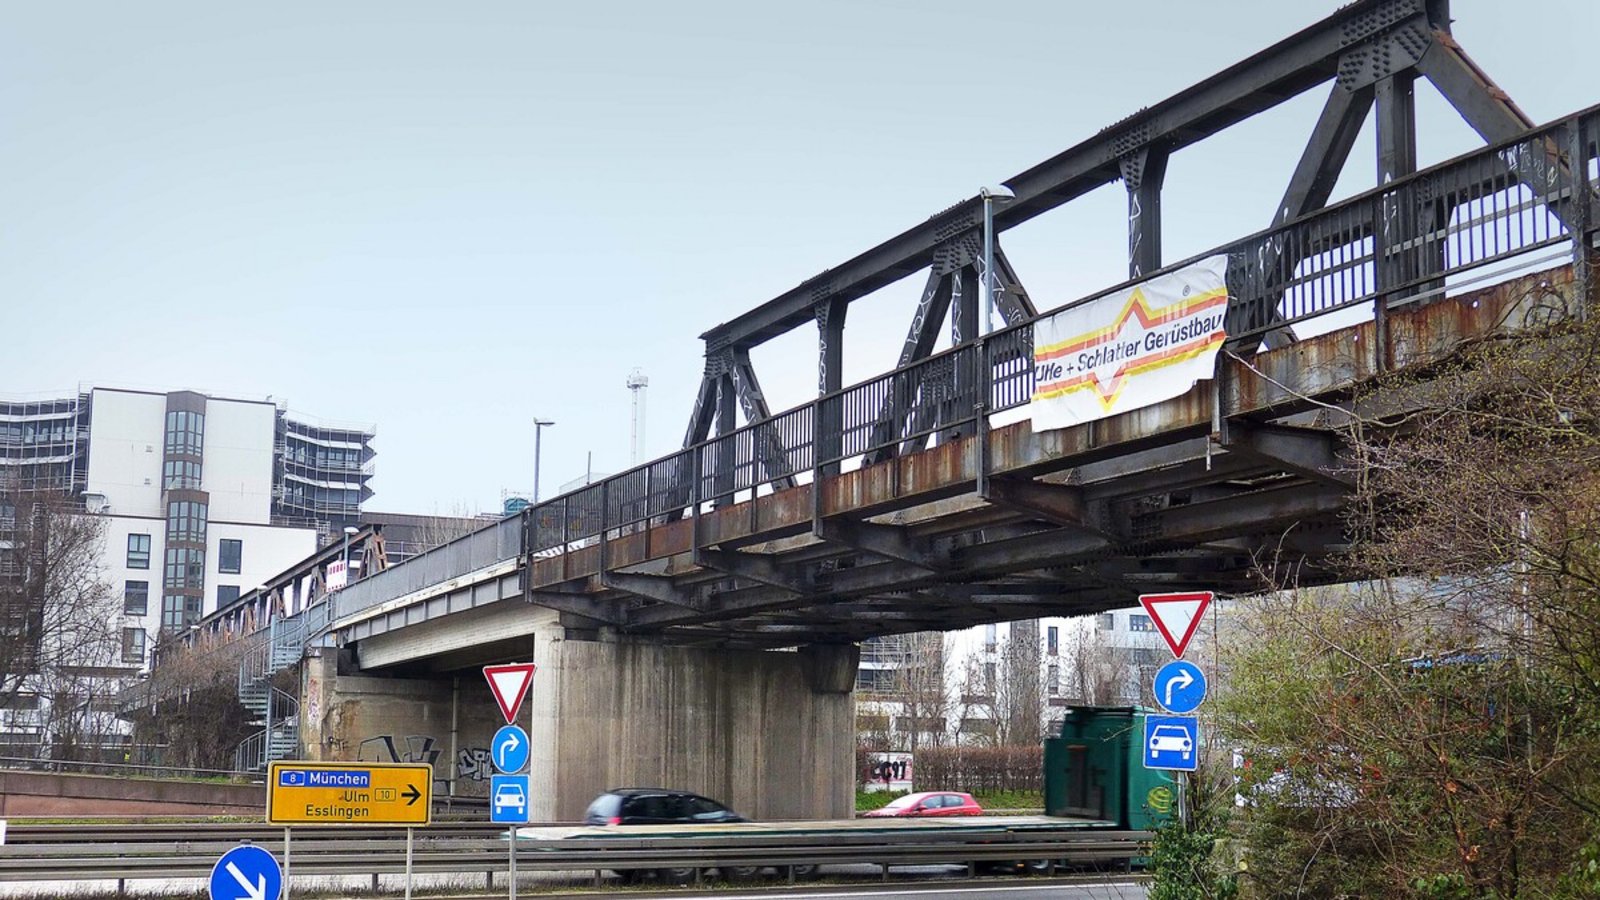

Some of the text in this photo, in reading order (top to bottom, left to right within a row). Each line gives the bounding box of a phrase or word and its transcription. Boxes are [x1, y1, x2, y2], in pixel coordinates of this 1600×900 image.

[1144, 314, 1222, 351] Gerüstbau
[309, 772, 369, 785] München
[344, 789, 391, 803] Ulm 10
[305, 804, 370, 819] Esslingen
